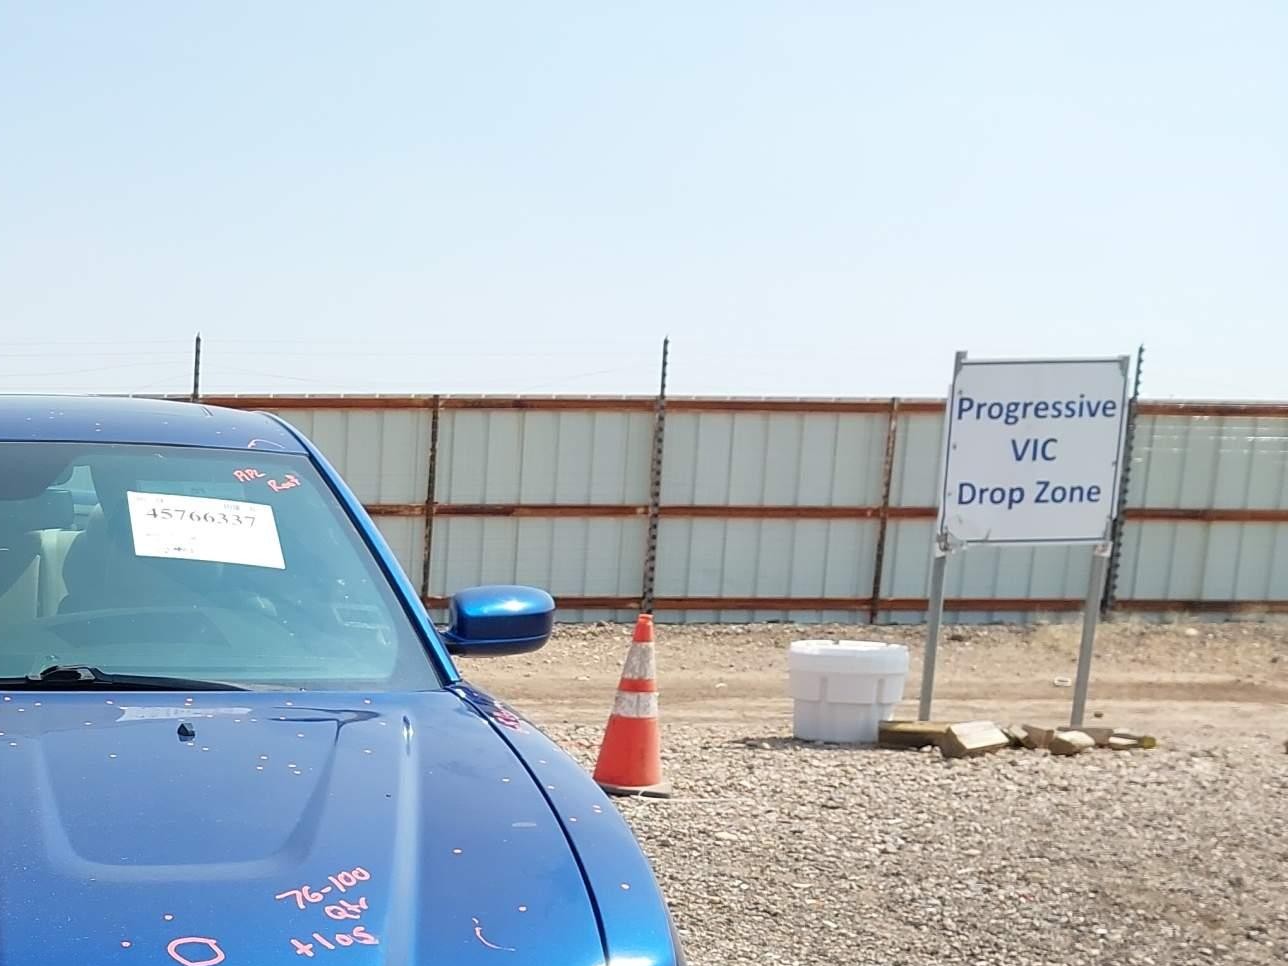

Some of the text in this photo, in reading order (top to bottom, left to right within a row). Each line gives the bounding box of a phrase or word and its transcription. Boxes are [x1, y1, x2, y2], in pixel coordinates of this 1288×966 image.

[957, 393, 1117, 425] Progressive
[1011, 438, 1058, 461] VIC
[957, 480, 1101, 510] Drop Zone
[145, 506, 257, 529] 45766337
[275, 866, 371, 910] 76-100
